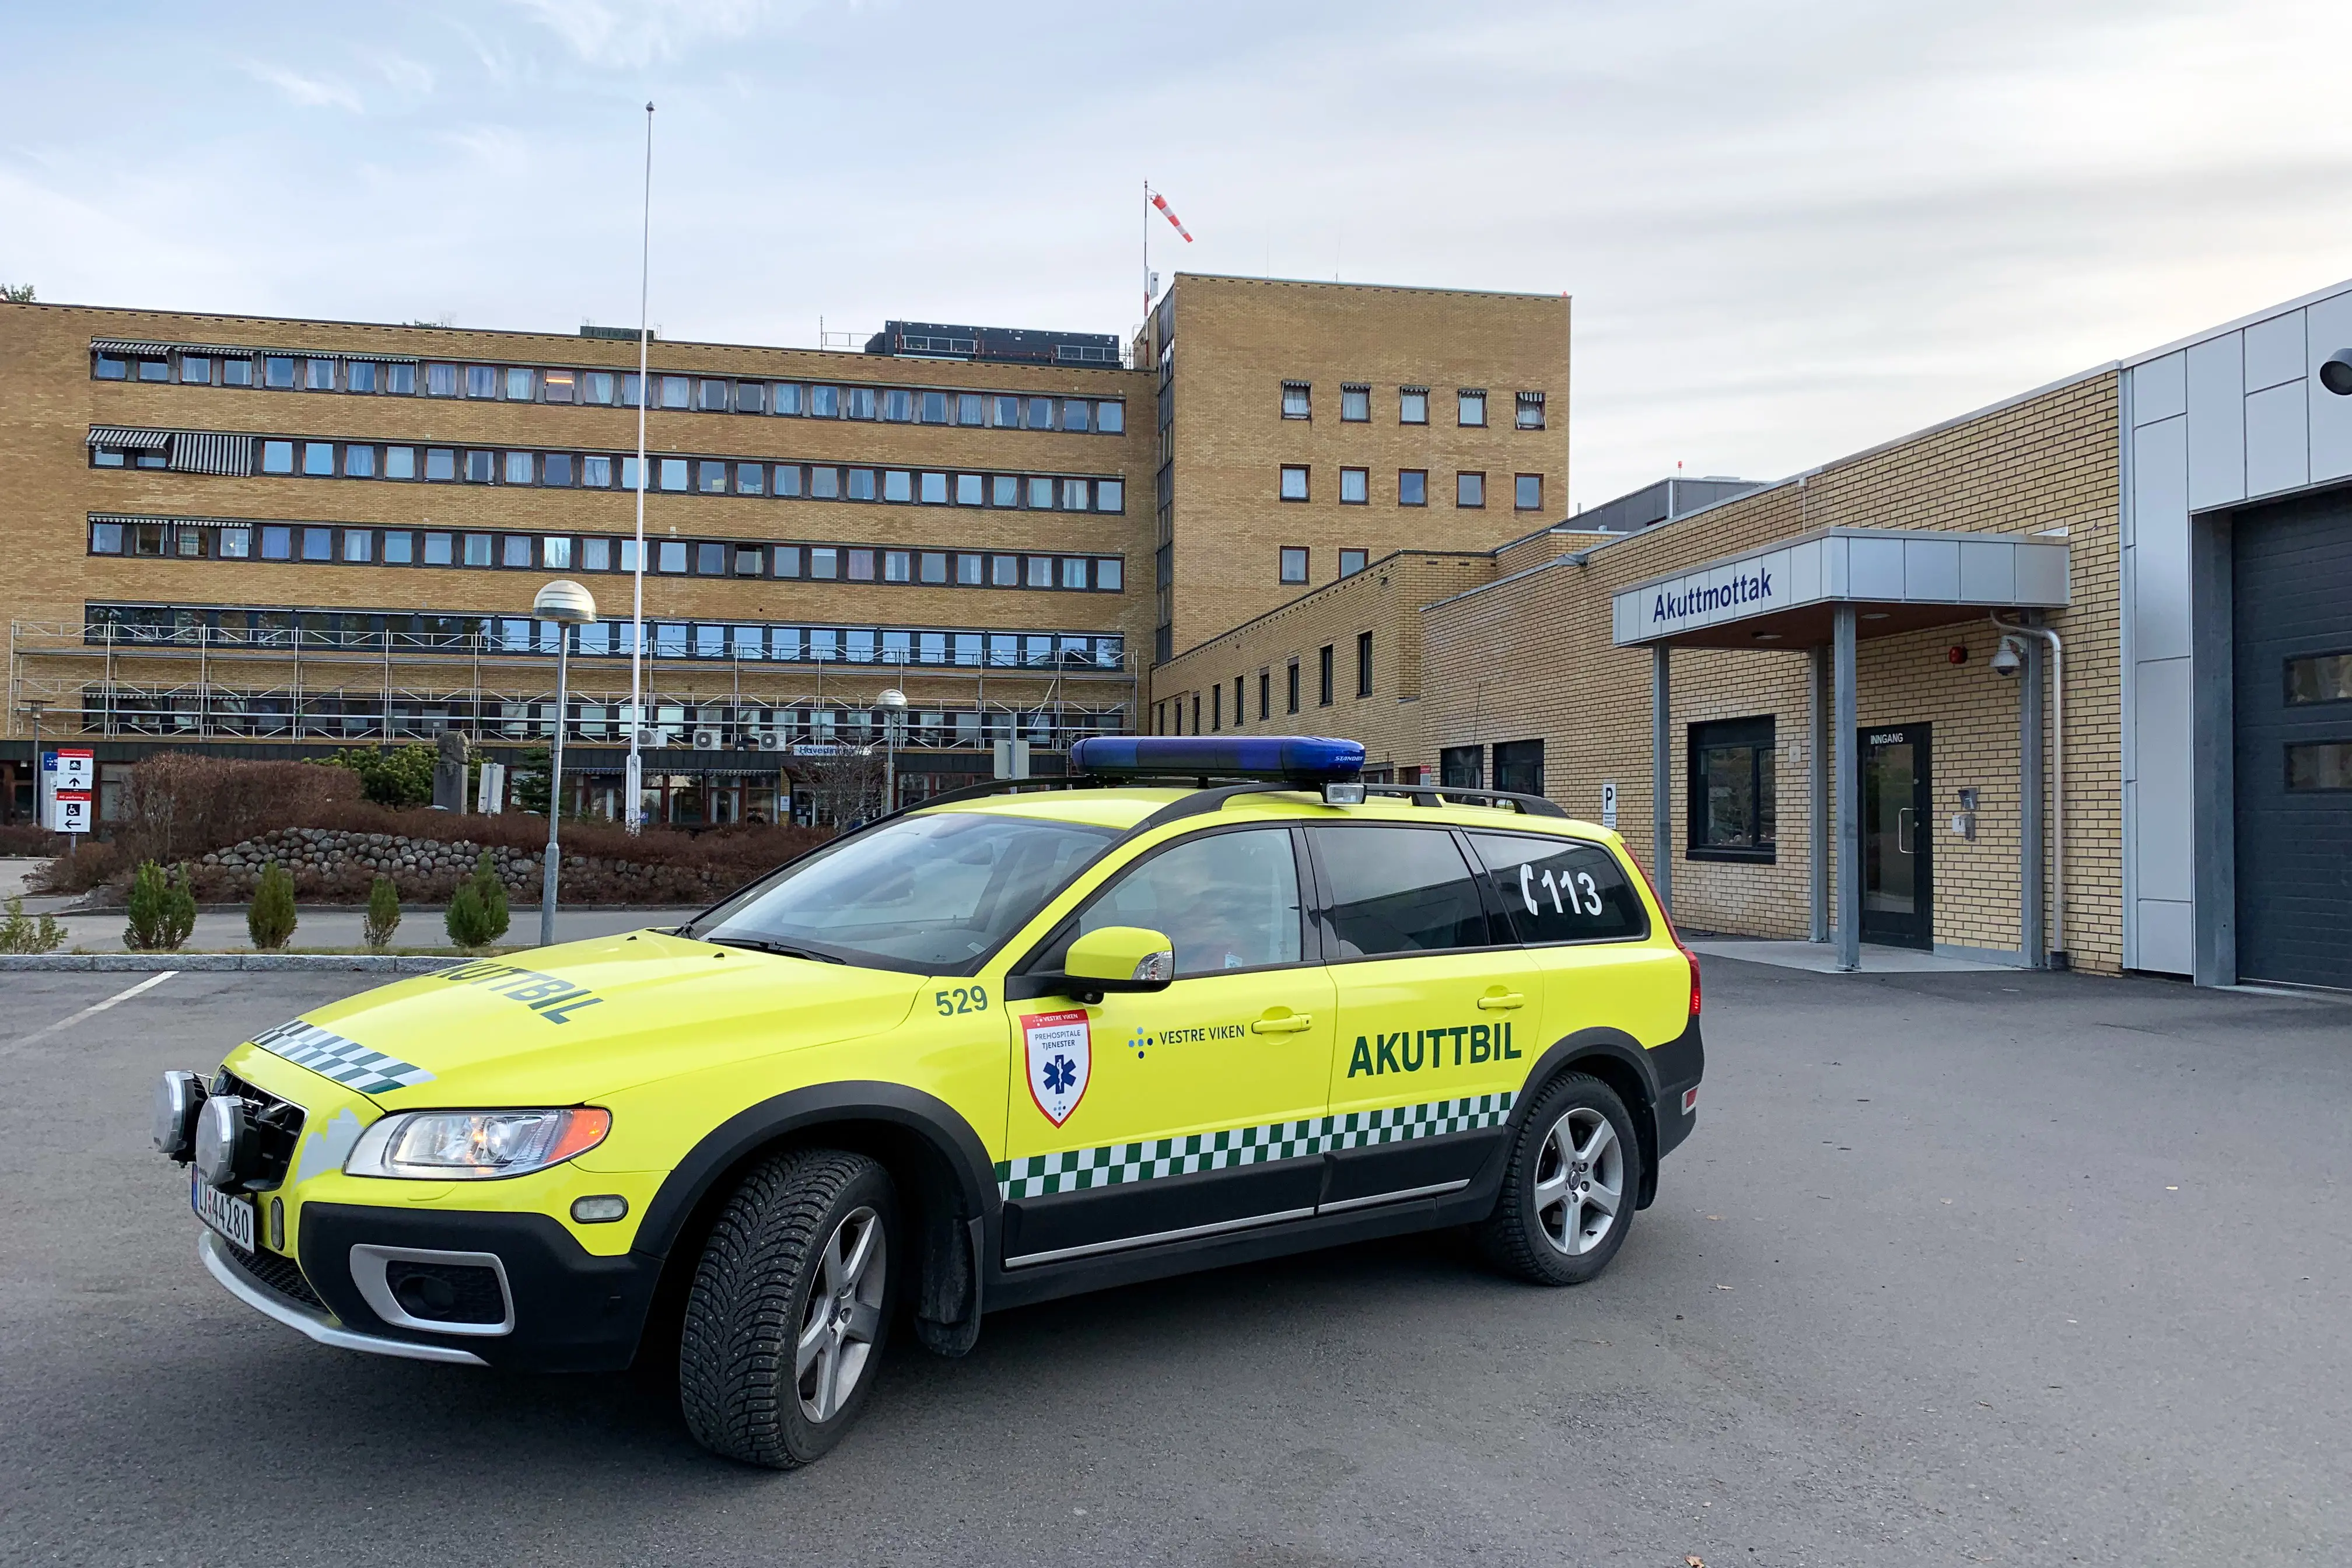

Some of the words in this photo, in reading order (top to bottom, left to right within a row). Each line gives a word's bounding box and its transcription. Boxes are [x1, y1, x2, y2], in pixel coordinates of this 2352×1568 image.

[1653, 567, 1772, 623] Akuttmottak
[1870, 733, 1903, 745] INNGANG
[1605, 787, 1613, 810] P
[1541, 869, 1603, 916] 113
[424, 963, 604, 1025] KUTTBIL
[936, 985, 988, 1016] 529
[1035, 1030, 1081, 1041] PREHOSPITALE
[1042, 1040, 1075, 1051] TJENESTER
[1159, 1028, 1206, 1045] VESTRE
[1208, 1024, 1245, 1041] VIKEN
[1347, 1022, 1522, 1079] AKUTTBIL
